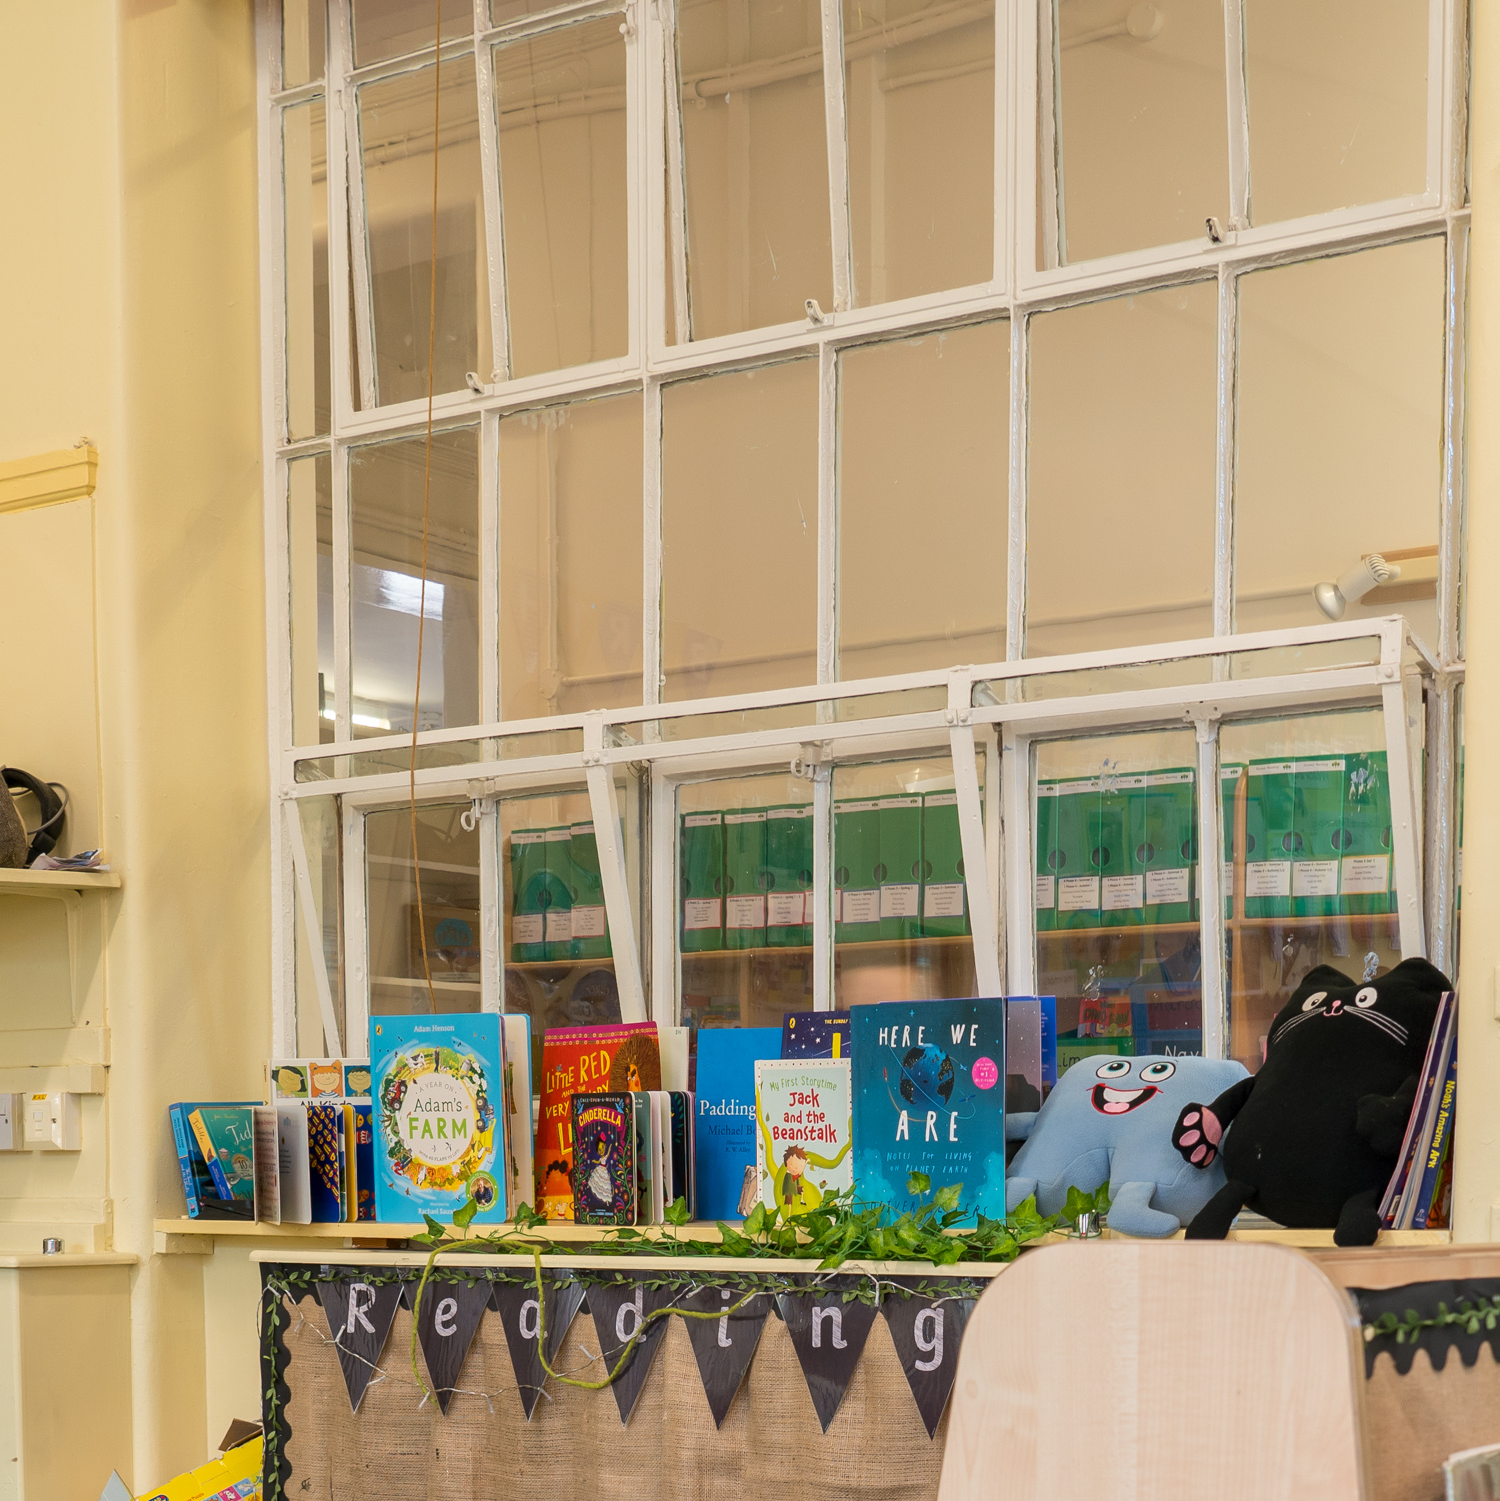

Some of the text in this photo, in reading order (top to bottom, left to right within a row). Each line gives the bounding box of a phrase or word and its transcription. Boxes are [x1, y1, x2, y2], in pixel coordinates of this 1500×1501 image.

[413, 1024, 455, 1033] Adam Henson
[879, 1024, 979, 1048] HERE WE
[579, 1050, 611, 1084] RED
[770, 1076, 837, 1091] My First Storytime
[1443, 1079, 1456, 1108] Noah's
[413, 1098, 463, 1113] Adam's
[789, 1088, 820, 1108] Jack
[545, 1101, 570, 1120] VERY
[578, 1108, 622, 1127] CINDERELLA
[783, 1110, 825, 1124] and the
[408, 1117, 467, 1139] FARM
[708, 1125, 743, 1136] Michael
[895, 1110, 959, 1142] ARE
[1432, 1107, 1450, 1147] Amazing
[345, 1281, 946, 1373] Reading
